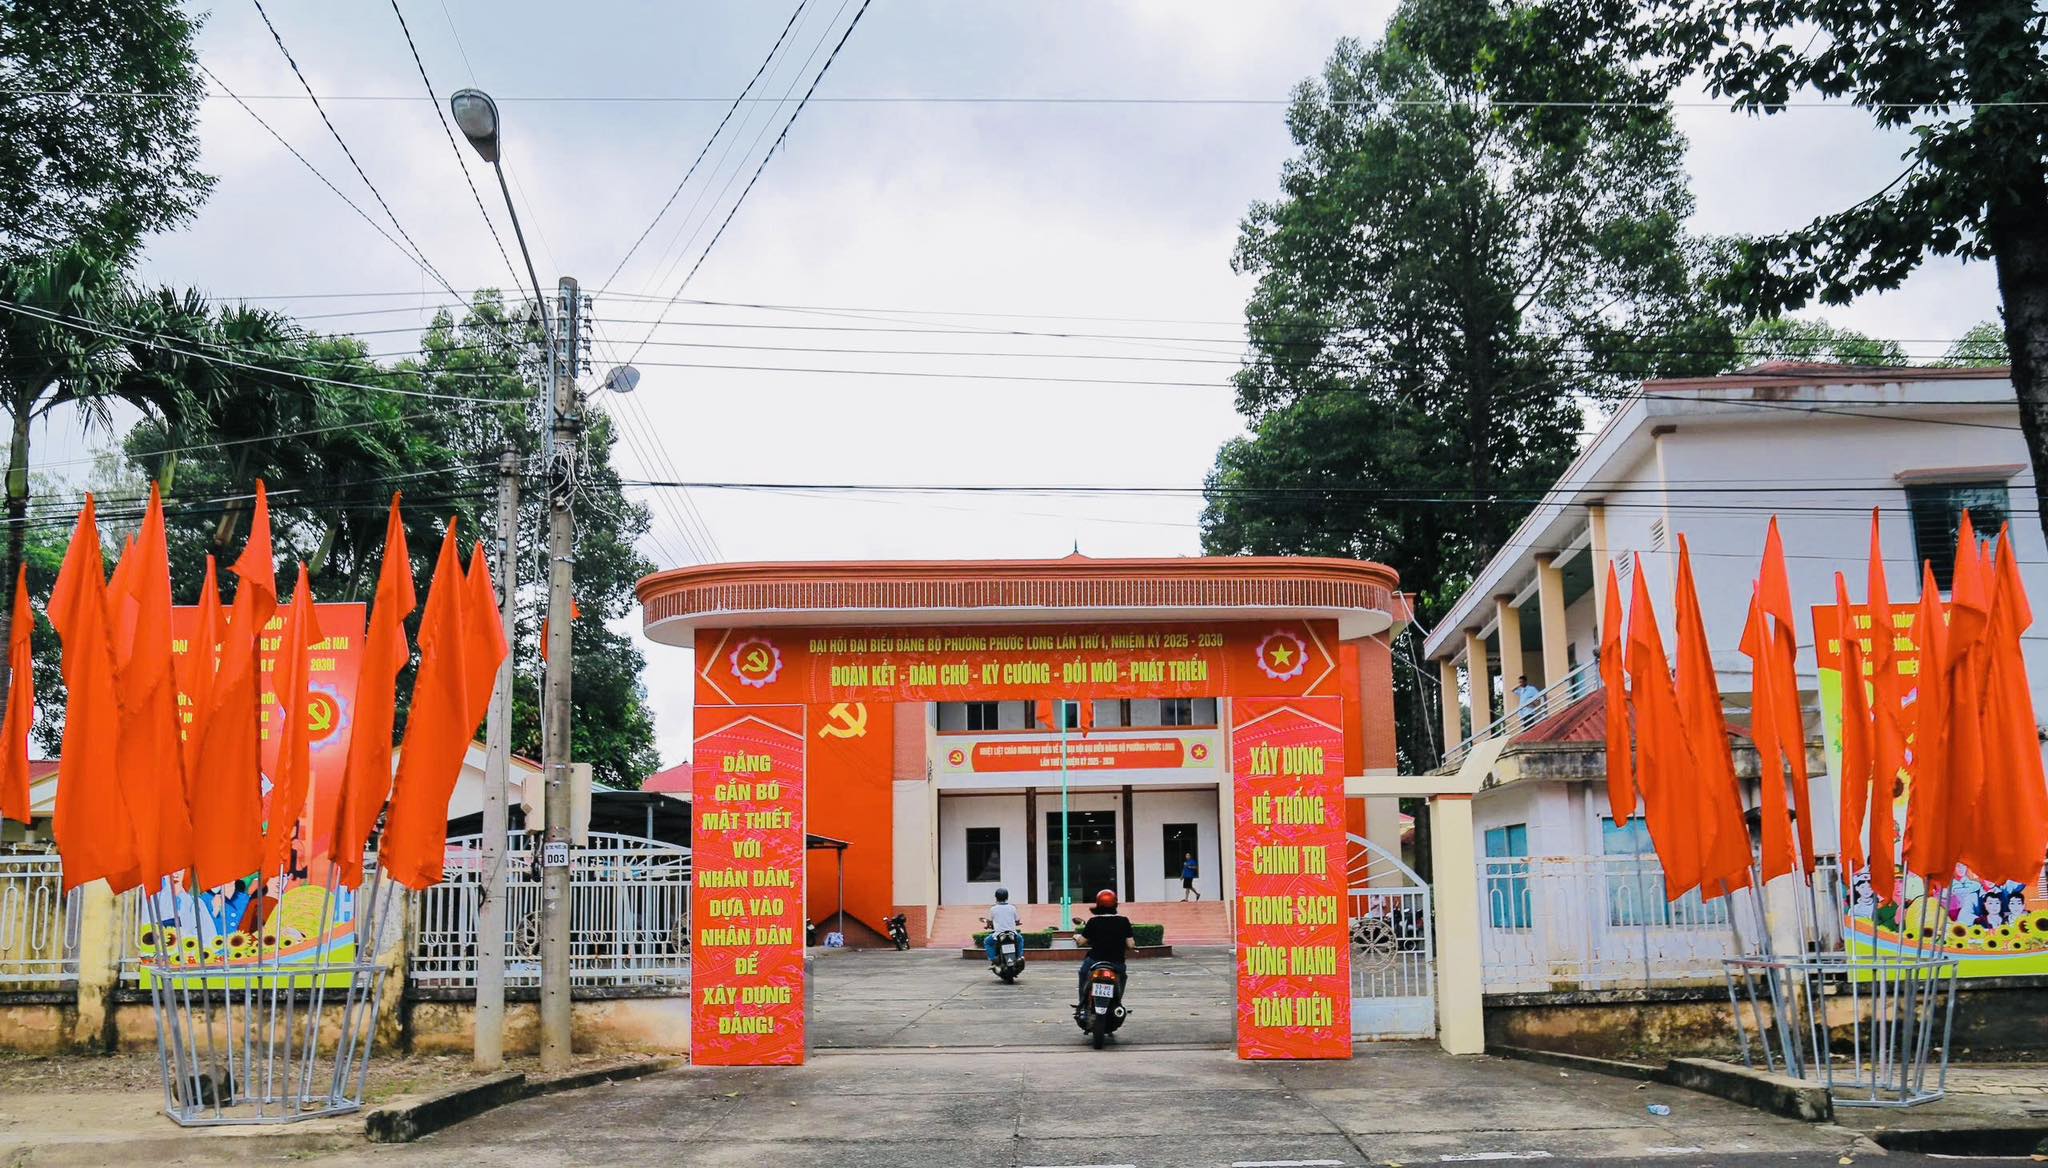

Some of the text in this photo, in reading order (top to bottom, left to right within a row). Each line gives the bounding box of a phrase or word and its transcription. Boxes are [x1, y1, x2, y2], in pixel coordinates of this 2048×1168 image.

[810, 639, 827, 655] ĐẠI
[830, 636, 847, 655] HỘI
[850, 639, 867, 655] ĐẠI
[870, 634, 893, 652] BIỂU
[897, 635, 924, 652] ĐẢNG
[928, 636, 942, 654] BỘ
[945, 634, 986, 651] PHƯỜNG
[990, 633, 1023, 650] PHƯỚC
[1027, 636, 1053, 650] LONG
[1057, 633, 1076, 649] LẦN
[1102, 636, 1109, 650] I,
[1111, 633, 1144, 651] NHIỆM
[1148, 632, 1160, 648] KỲ
[1164, 633, 1188, 648] 2025
[1199, 633, 1223, 647] 2030
[831, 662, 868, 686] ĐOÀN
[872, 658, 896, 686] KẾT
[909, 661, 937, 686] DÂN
[941, 659, 969, 685] CHỦ
[1003, 660, 1050, 685] CƯƠNG
[1063, 655, 1087, 683] ĐỔI
[1091, 658, 1118, 683] MỚI
[1130, 658, 1166, 682] PHÁT
[1169, 653, 1207, 681] TRIỂN
[723, 750, 771, 773] ĐẢNG
[1250, 741, 1325, 782] XÂY DỰNG
[715, 778, 780, 801] GẮN BÓ
[702, 807, 792, 834] MẬT THIẾT
[1252, 787, 1325, 831] HỆ THỐNG
[733, 838, 761, 858] VỚI
[1253, 840, 1327, 880] CHÍNH TRỊ
[699, 866, 795, 889] NHÂN DÂN,
[709, 895, 784, 920] DỰA VÀO
[1243, 895, 1338, 931] TRONG SẠCH
[701, 924, 792, 946] NHÂN DÂN
[735, 950, 759, 975] ĐỂ
[1246, 941, 1337, 982] VỮNG MẠNH
[703, 984, 792, 1008] XÂY DỰNG
[719, 1011, 774, 1034] ĐẢNG!
[1252, 991, 1332, 1033] TOÀN DIỆN
